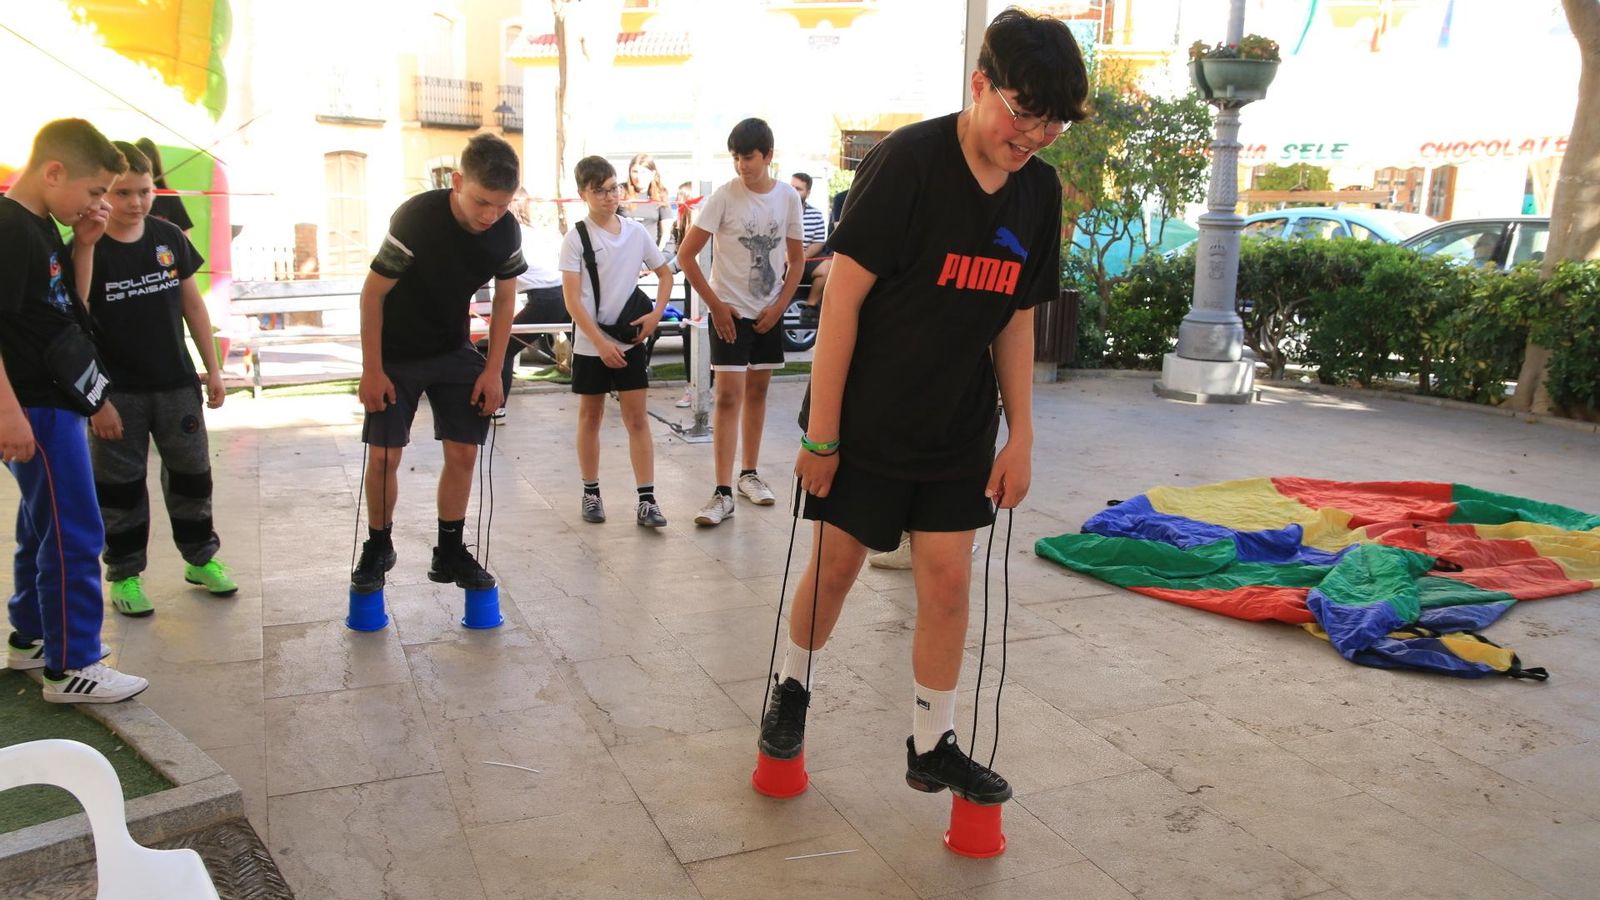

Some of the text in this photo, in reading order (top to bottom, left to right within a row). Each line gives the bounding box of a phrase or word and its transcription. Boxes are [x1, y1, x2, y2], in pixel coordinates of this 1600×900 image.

[1280, 143, 1349, 160] SELE
[106, 278, 180, 302] DE PAISANO
[86, 372, 110, 407] PUMA
